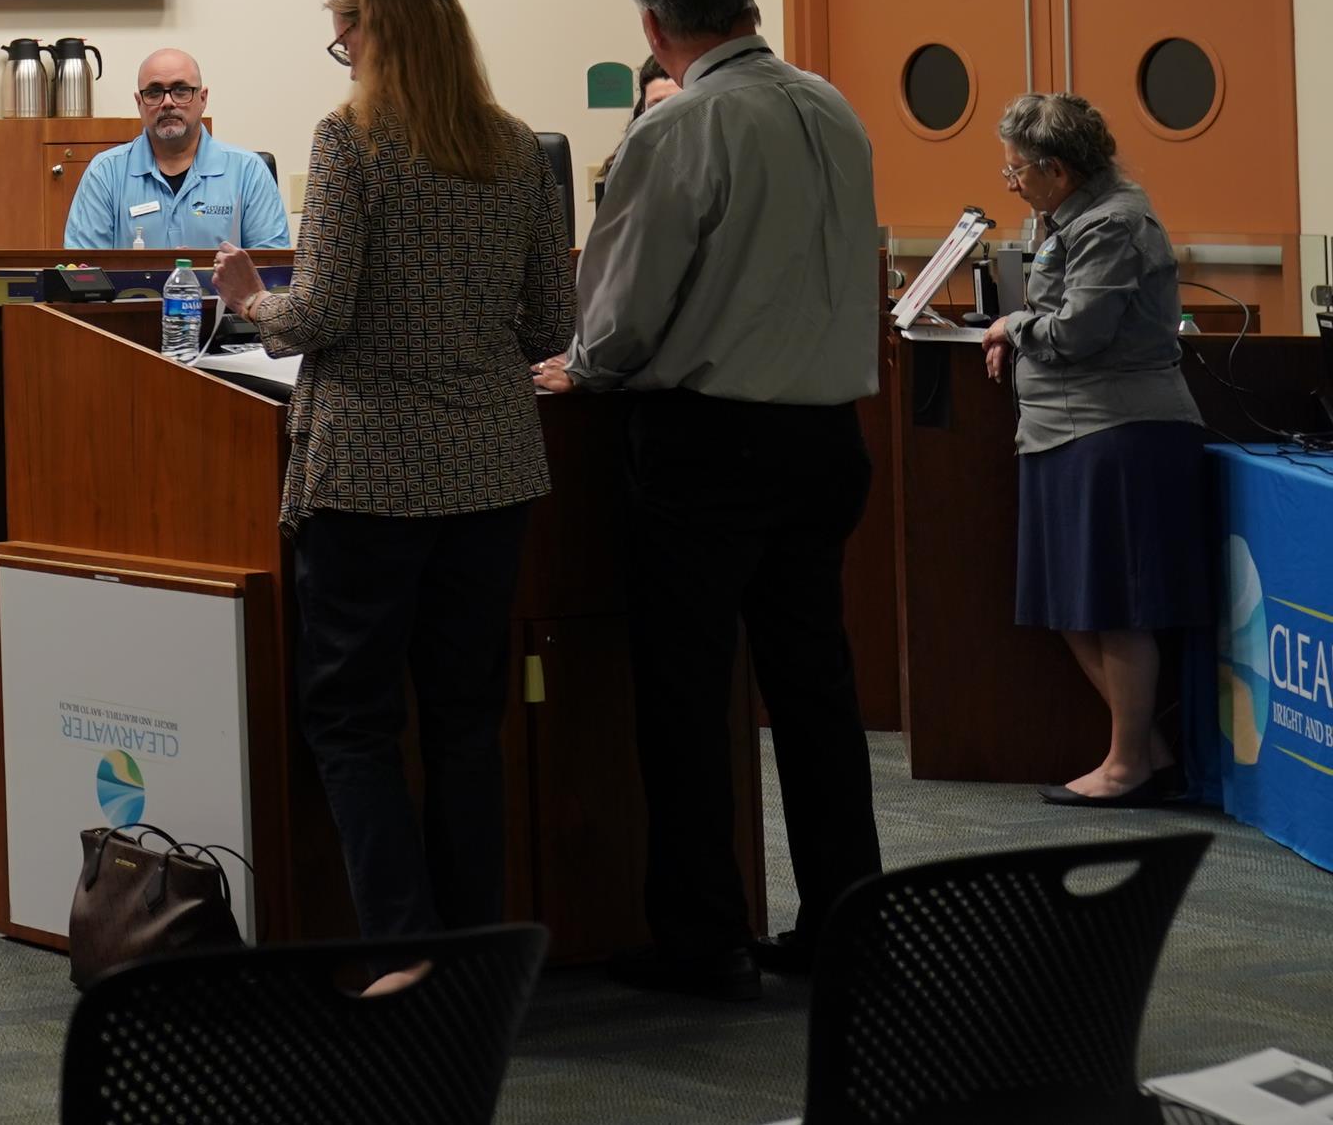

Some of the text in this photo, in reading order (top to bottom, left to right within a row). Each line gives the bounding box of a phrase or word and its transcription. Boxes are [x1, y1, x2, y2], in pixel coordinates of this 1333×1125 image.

[1270, 623, 1333, 709] CLEA
[60, 714, 179, 757] CLEARWATER
[1304, 716, 1324, 744] AND
